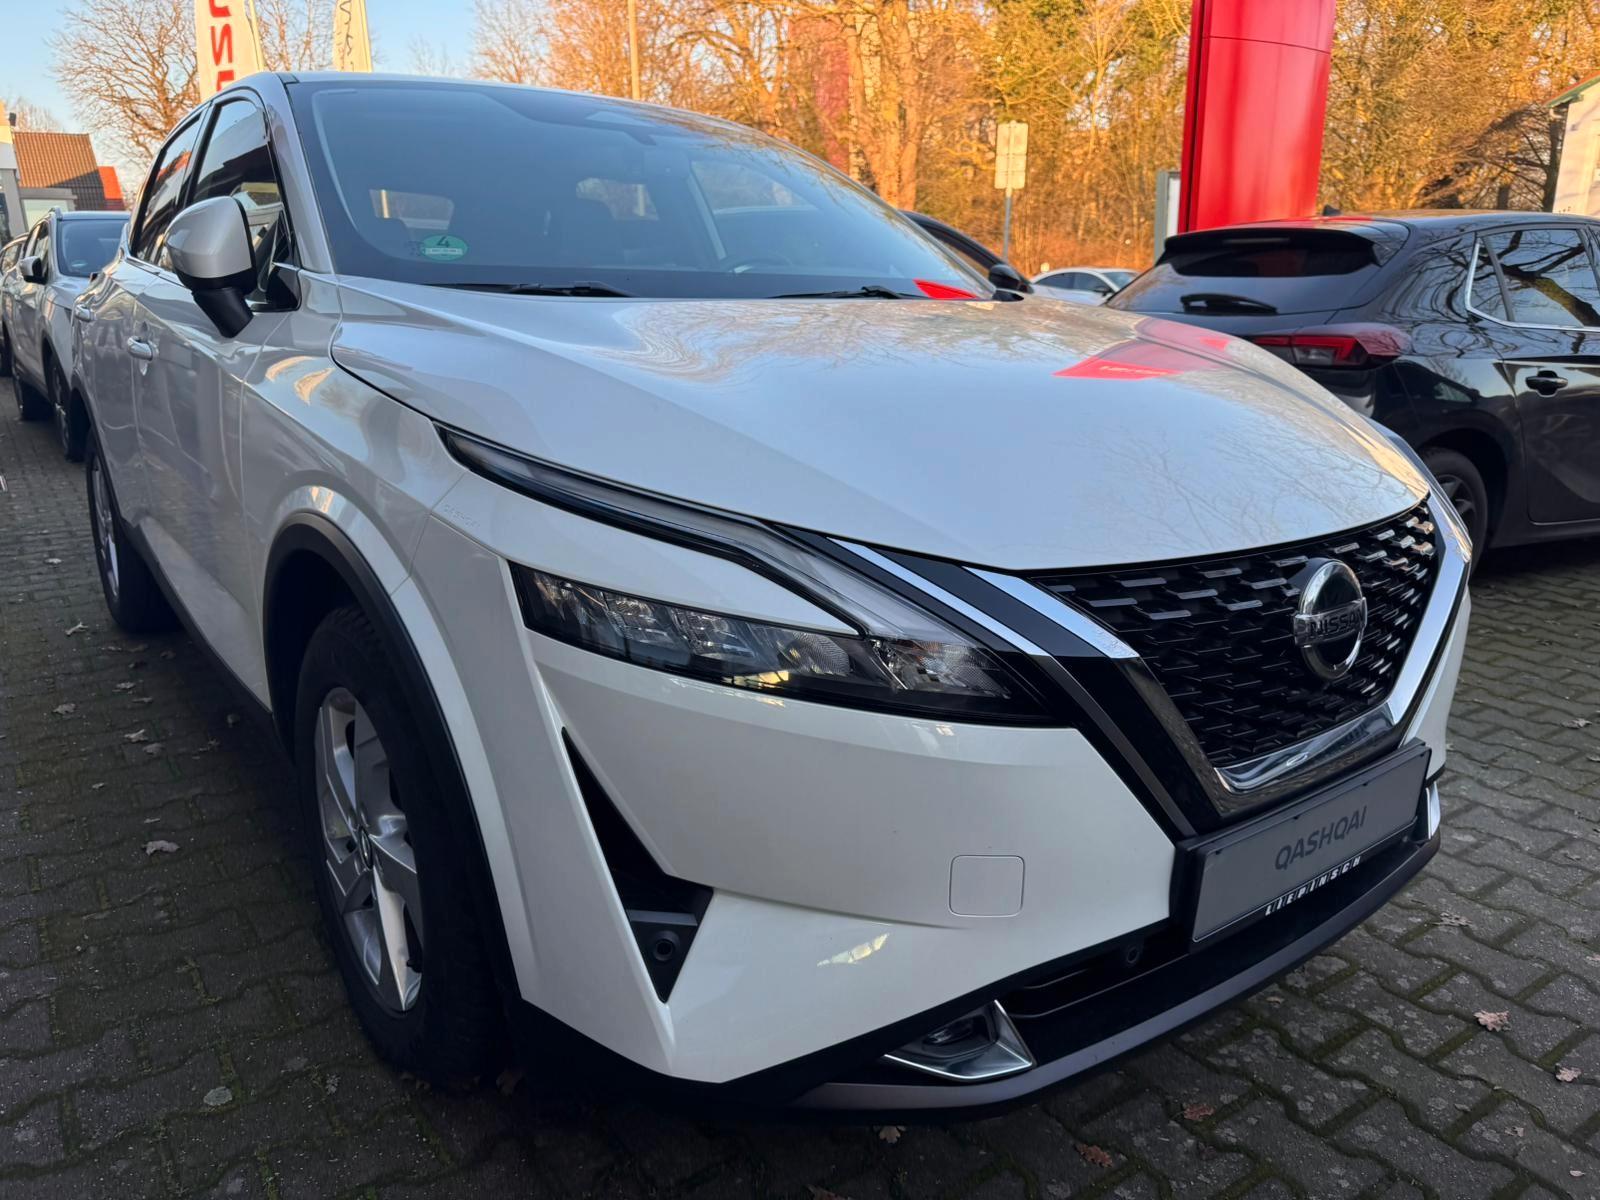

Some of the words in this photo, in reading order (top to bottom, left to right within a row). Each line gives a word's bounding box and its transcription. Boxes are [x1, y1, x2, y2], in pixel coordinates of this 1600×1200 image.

[436, 235, 450, 248] 4
[1309, 609, 1364, 639] NISSAN
[1274, 806, 1367, 871] QASHQAI
[1264, 856, 1361, 916] LIEPINSCH
